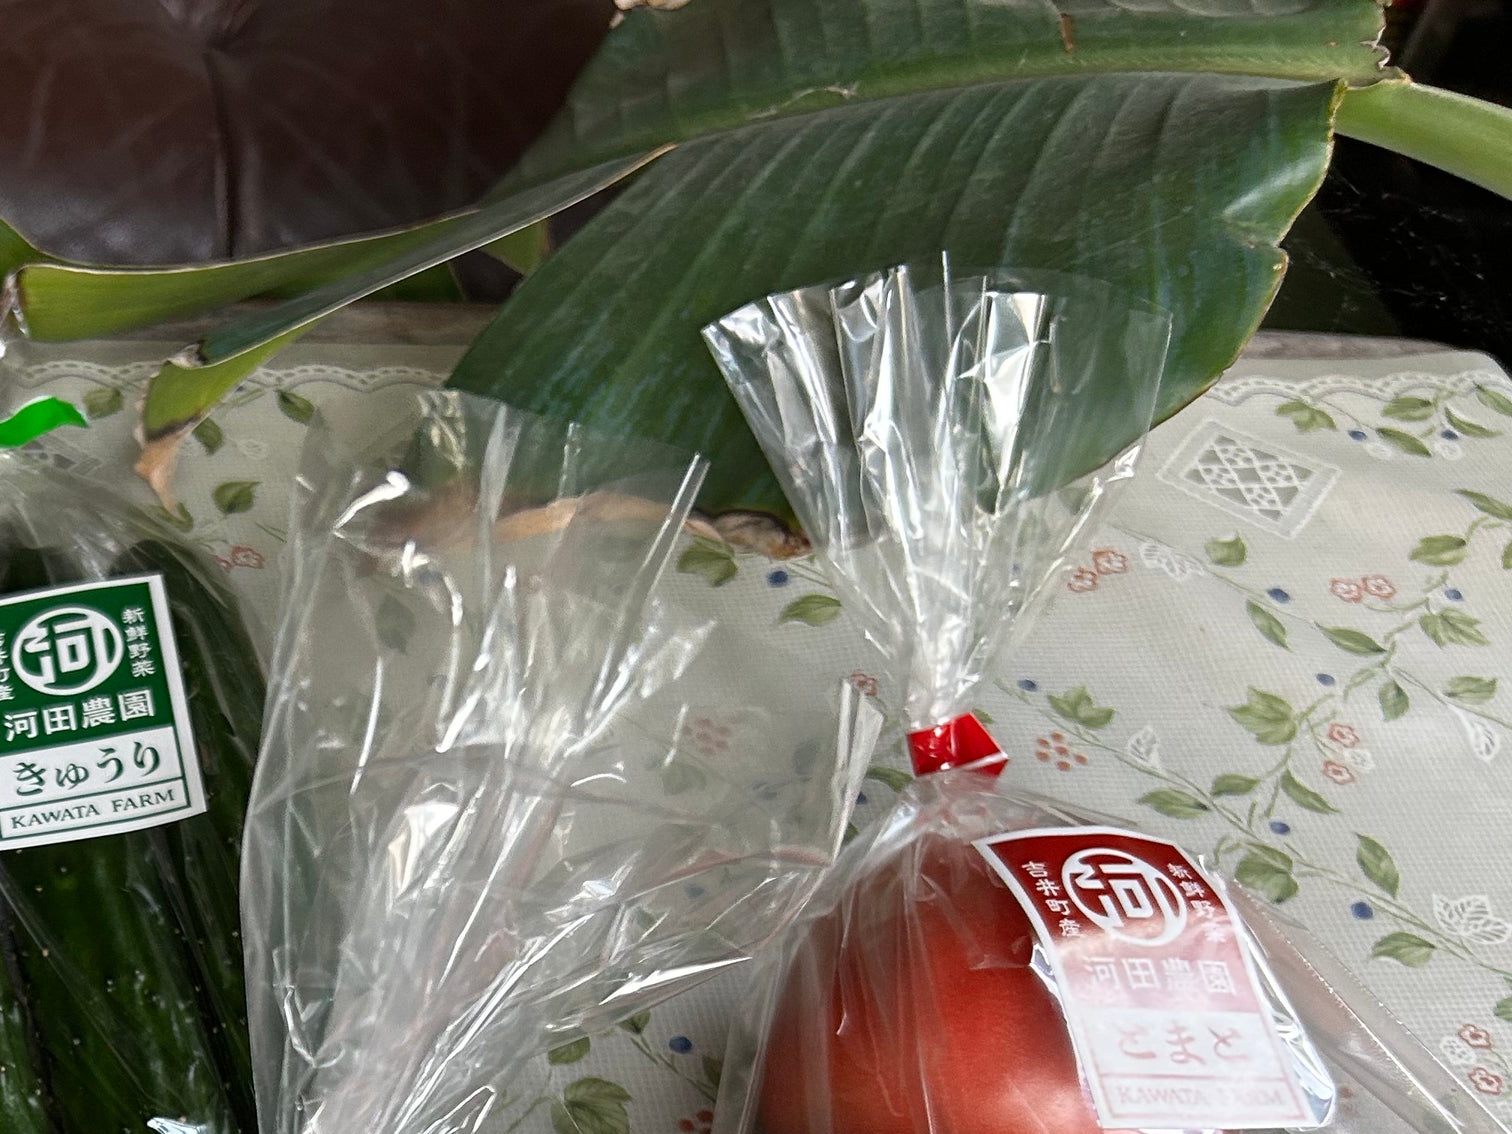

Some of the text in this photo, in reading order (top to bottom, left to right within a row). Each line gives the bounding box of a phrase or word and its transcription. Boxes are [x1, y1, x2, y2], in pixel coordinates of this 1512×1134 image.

[122, 608, 156, 678] 新鮮野菜
[4, 690, 155, 742] 河田農園
[13, 741, 160, 796] きゅうり
[11, 789, 175, 829] KAWATA FARM
[1085, 957, 1236, 997] 河田農園
